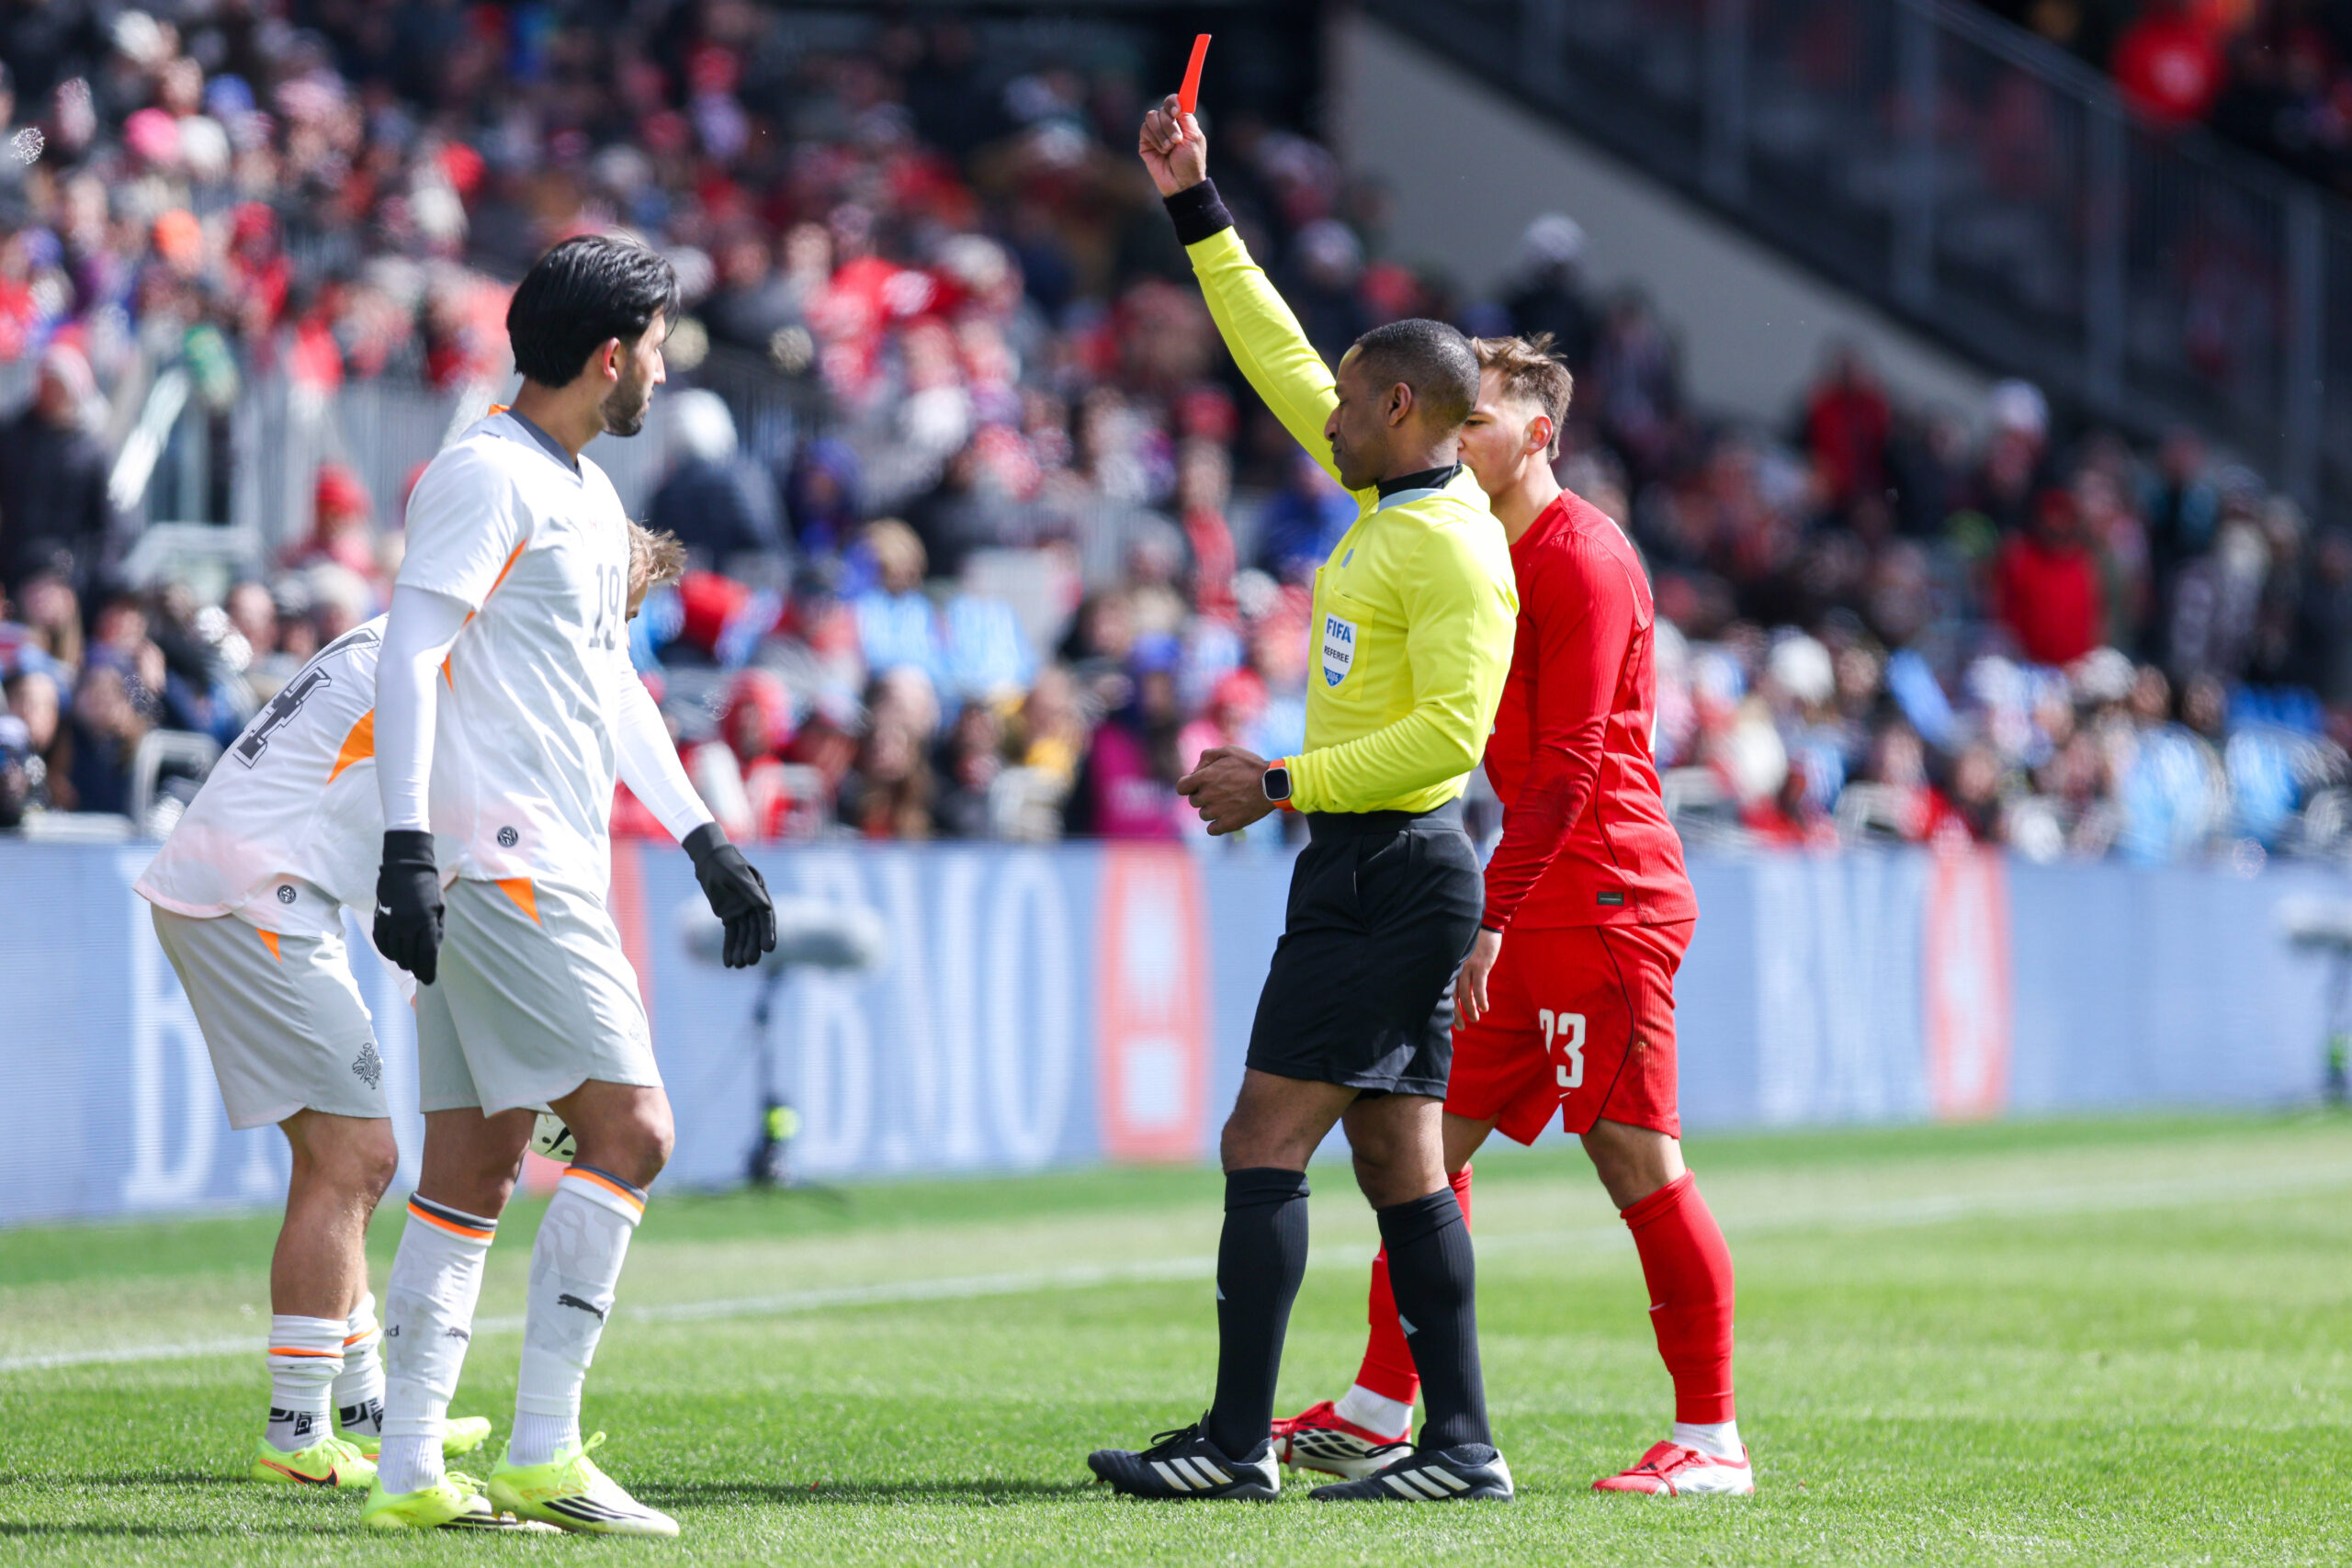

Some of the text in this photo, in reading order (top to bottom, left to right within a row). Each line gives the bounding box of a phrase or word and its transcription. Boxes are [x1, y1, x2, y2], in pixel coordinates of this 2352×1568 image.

[589, 563, 620, 650] 19
[1326, 617, 1351, 644] FIFA
[1324, 645, 1350, 663] REFEREE
